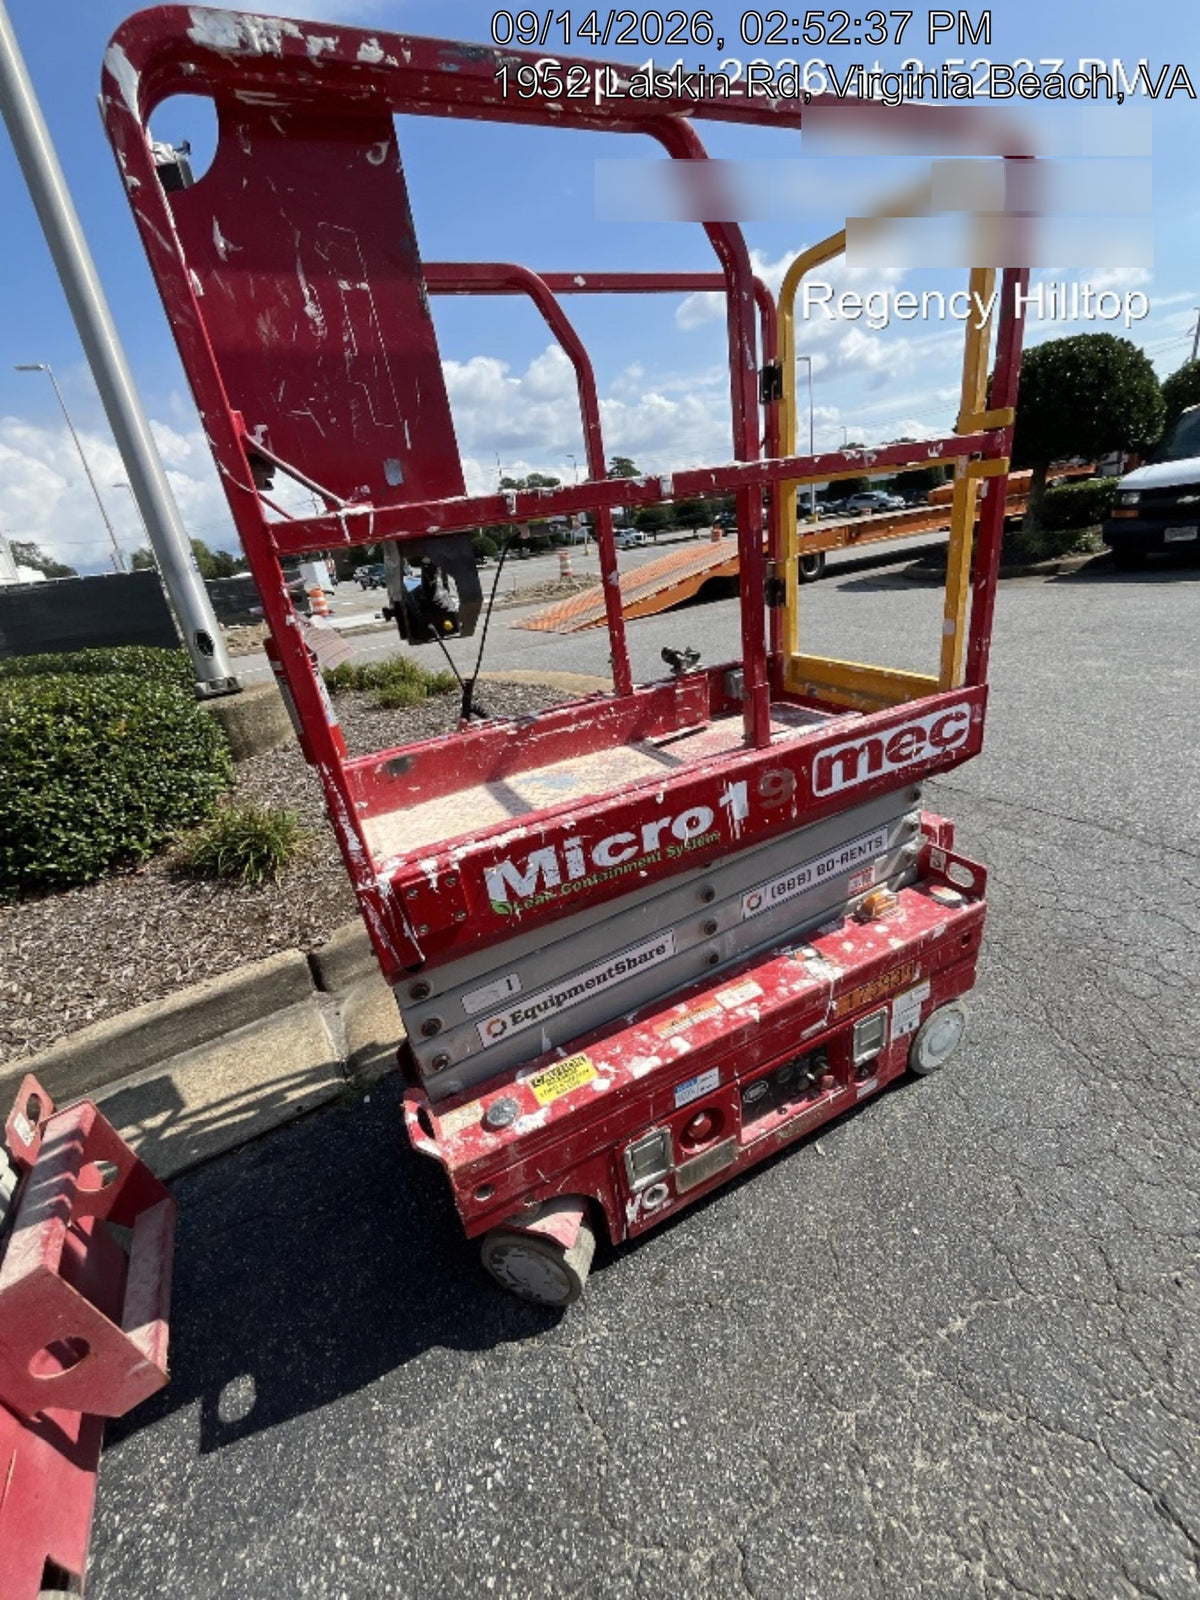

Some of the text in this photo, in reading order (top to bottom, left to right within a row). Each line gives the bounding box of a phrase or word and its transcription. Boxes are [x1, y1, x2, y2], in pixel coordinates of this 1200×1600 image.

[817, 710, 969, 789] mec
[560, 852, 662, 895] Containment
[510, 944, 667, 1026] EquipmentShare
